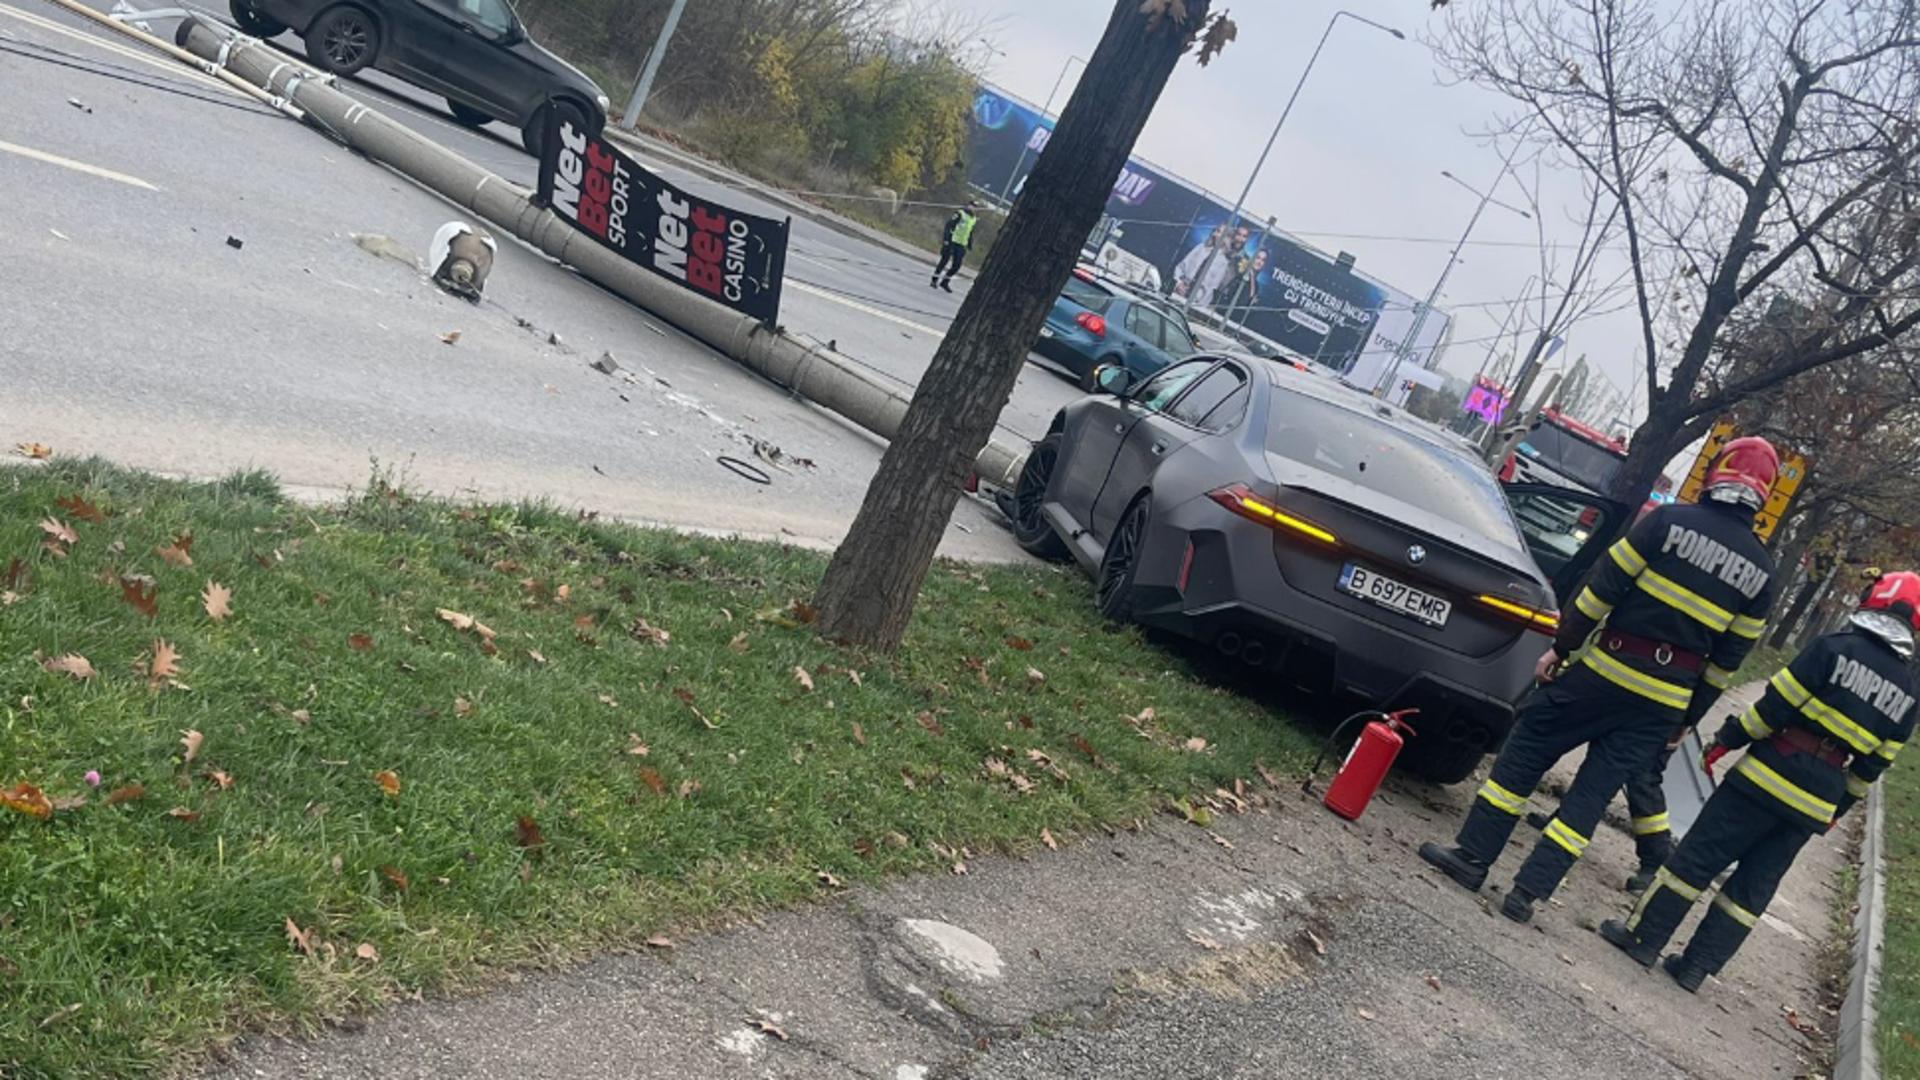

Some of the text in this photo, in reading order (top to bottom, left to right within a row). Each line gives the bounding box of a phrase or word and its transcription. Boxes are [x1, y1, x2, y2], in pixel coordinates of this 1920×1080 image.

[551, 121, 587, 220] Net
[577, 143, 616, 239] Bet
[609, 160, 631, 248] SPORT
[1114, 167, 1152, 199] DAY
[654, 189, 690, 280] Net
[687, 207, 727, 295] Bet
[724, 219, 749, 302] CASINO
[1351, 569, 1367, 589] B
